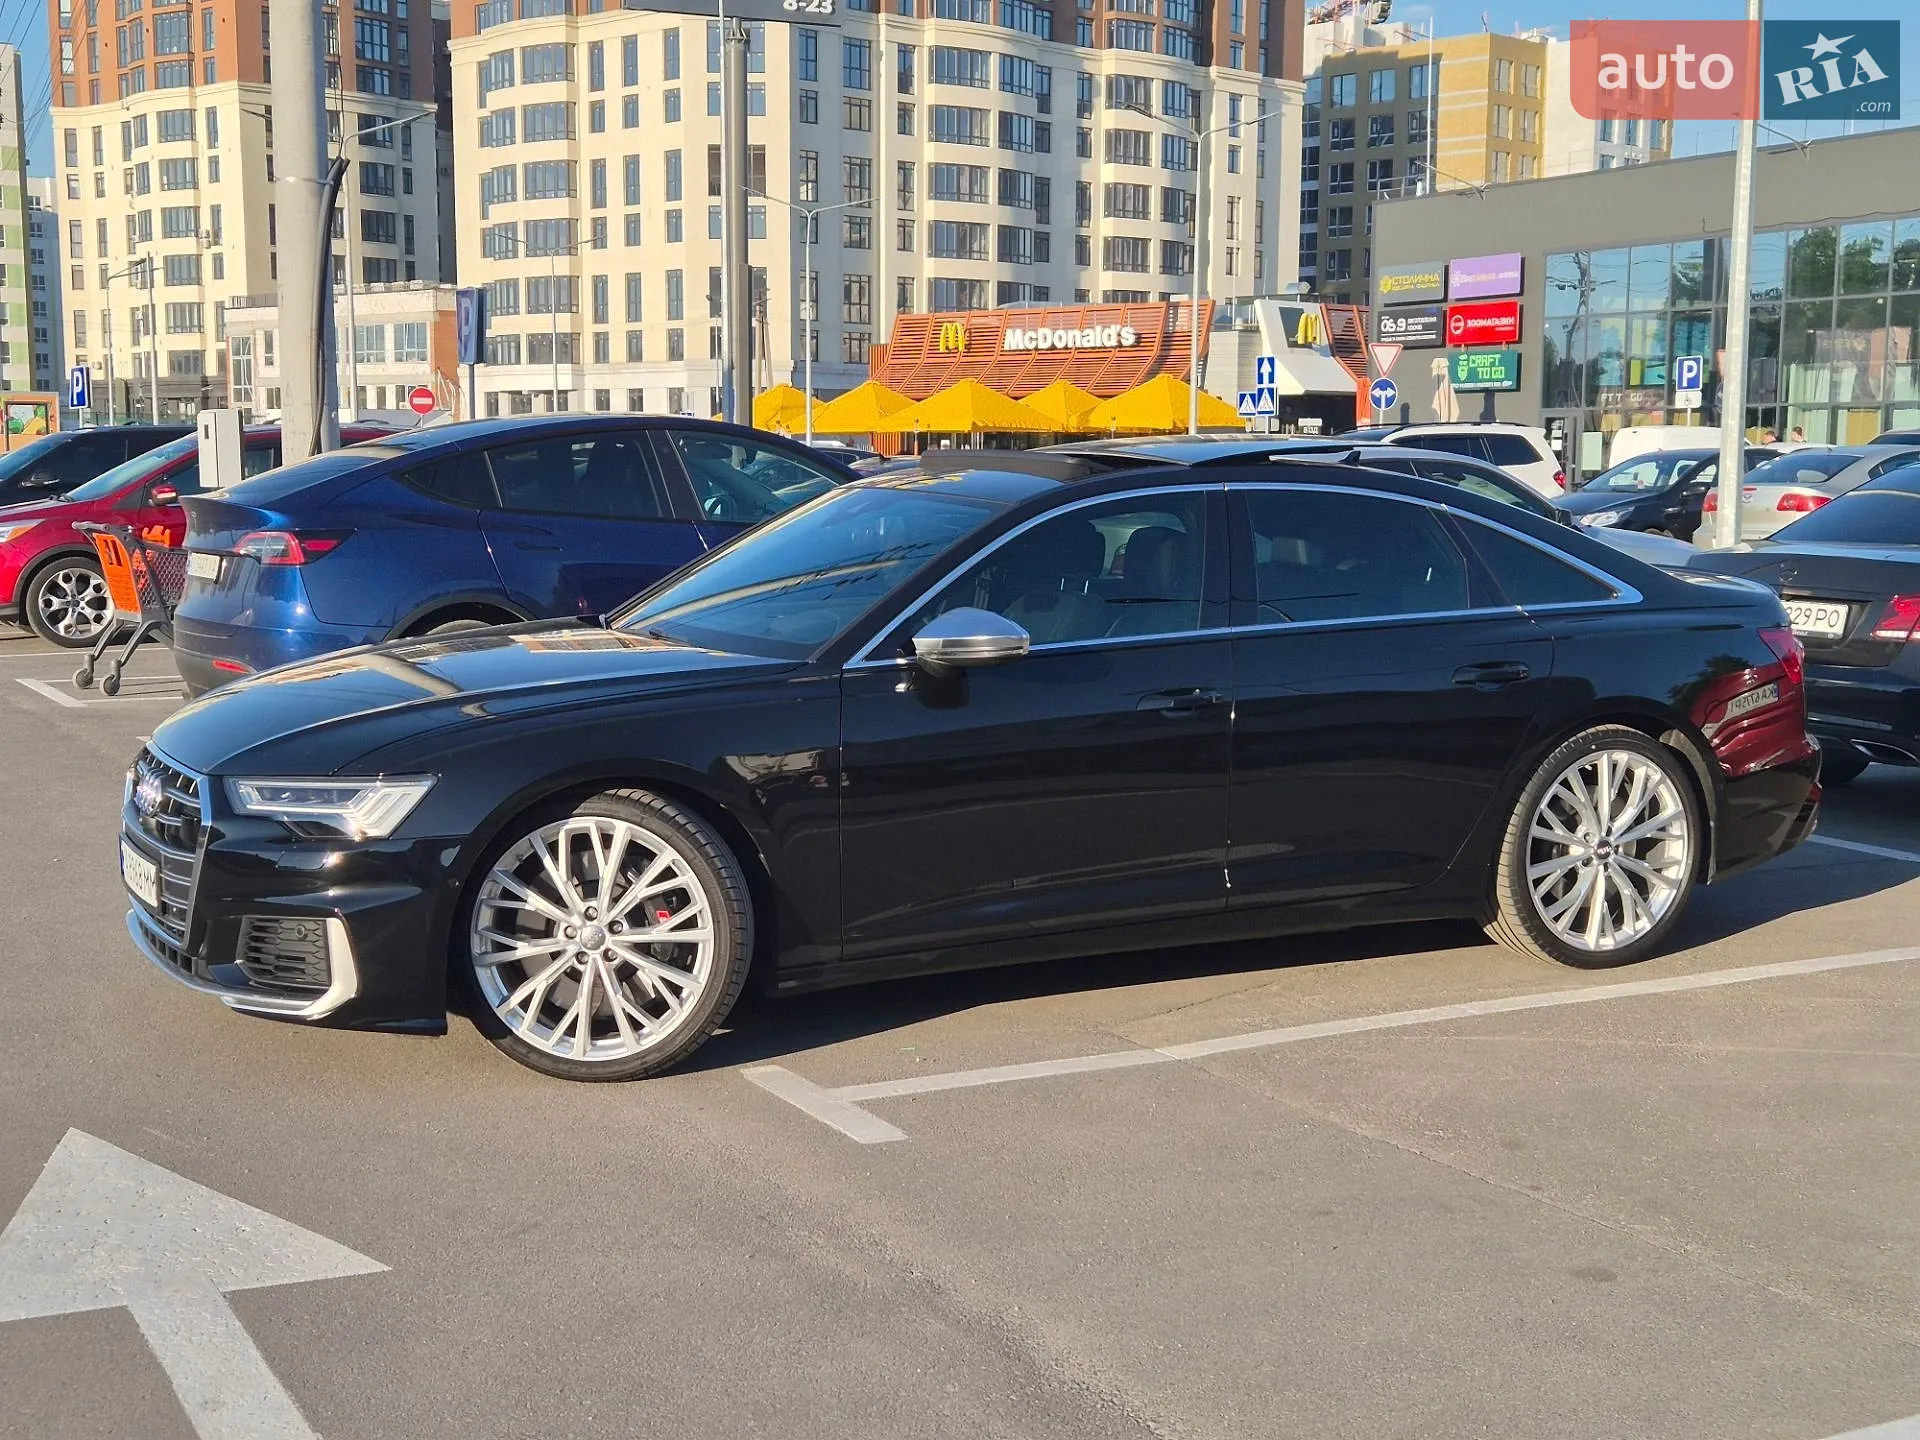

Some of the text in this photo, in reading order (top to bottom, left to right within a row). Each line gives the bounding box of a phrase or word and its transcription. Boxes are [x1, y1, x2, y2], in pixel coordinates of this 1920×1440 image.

[1003, 325, 1137, 351] McDonald's
[1469, 354, 1501, 367] CRAFT
[1477, 366, 1505, 379] TO GO
[1682, 360, 1698, 387] P
[73, 371, 83, 405] P
